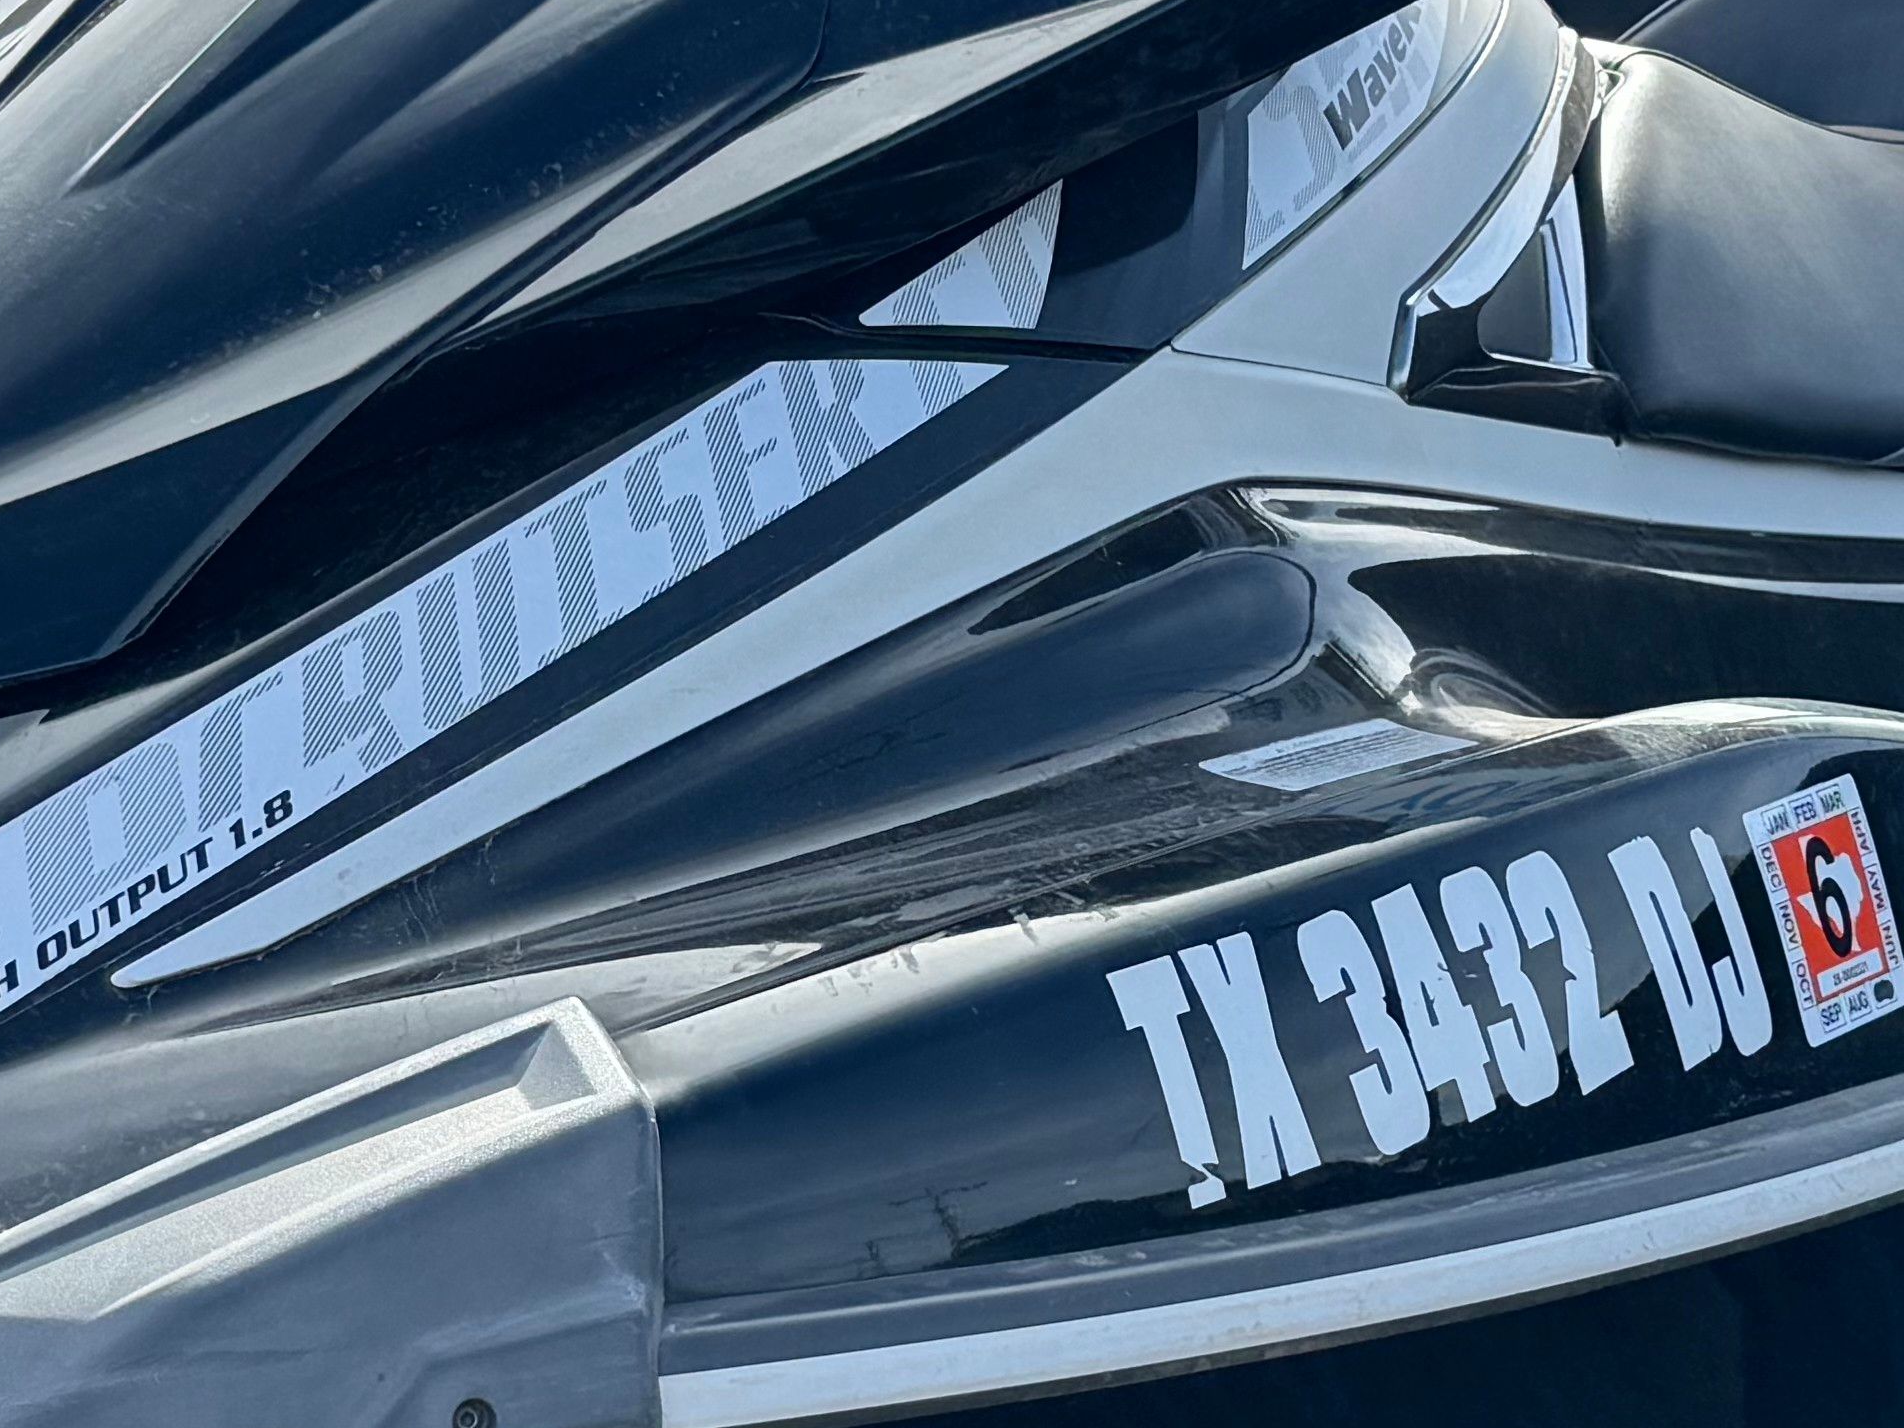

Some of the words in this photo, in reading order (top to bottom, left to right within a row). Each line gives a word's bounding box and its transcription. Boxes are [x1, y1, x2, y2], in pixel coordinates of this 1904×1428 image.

[1767, 811, 1792, 835] JAN
[1793, 801, 1817, 824] FEB
[1819, 790, 1846, 813] MAR
[1850, 811, 1870, 851] APR
[36, 837, 214, 971] OUTPUT
[229, 788, 294, 850] 1.8
[1805, 836, 1853, 958] 6
[1867, 870, 1885, 909] MAY
[1760, 846, 1782, 888] DEC
[1778, 904, 1799, 944] NOV
[1795, 962, 1814, 1006] OCT
[1883, 925, 1899, 968] JUN
[1106, 931, 1321, 1209] TX
[1297, 850, 1634, 1156] 3432
[1607, 827, 1773, 1072] DJ
[1820, 1002, 1842, 1026] SEP
[1848, 990, 1870, 1014] AUG
